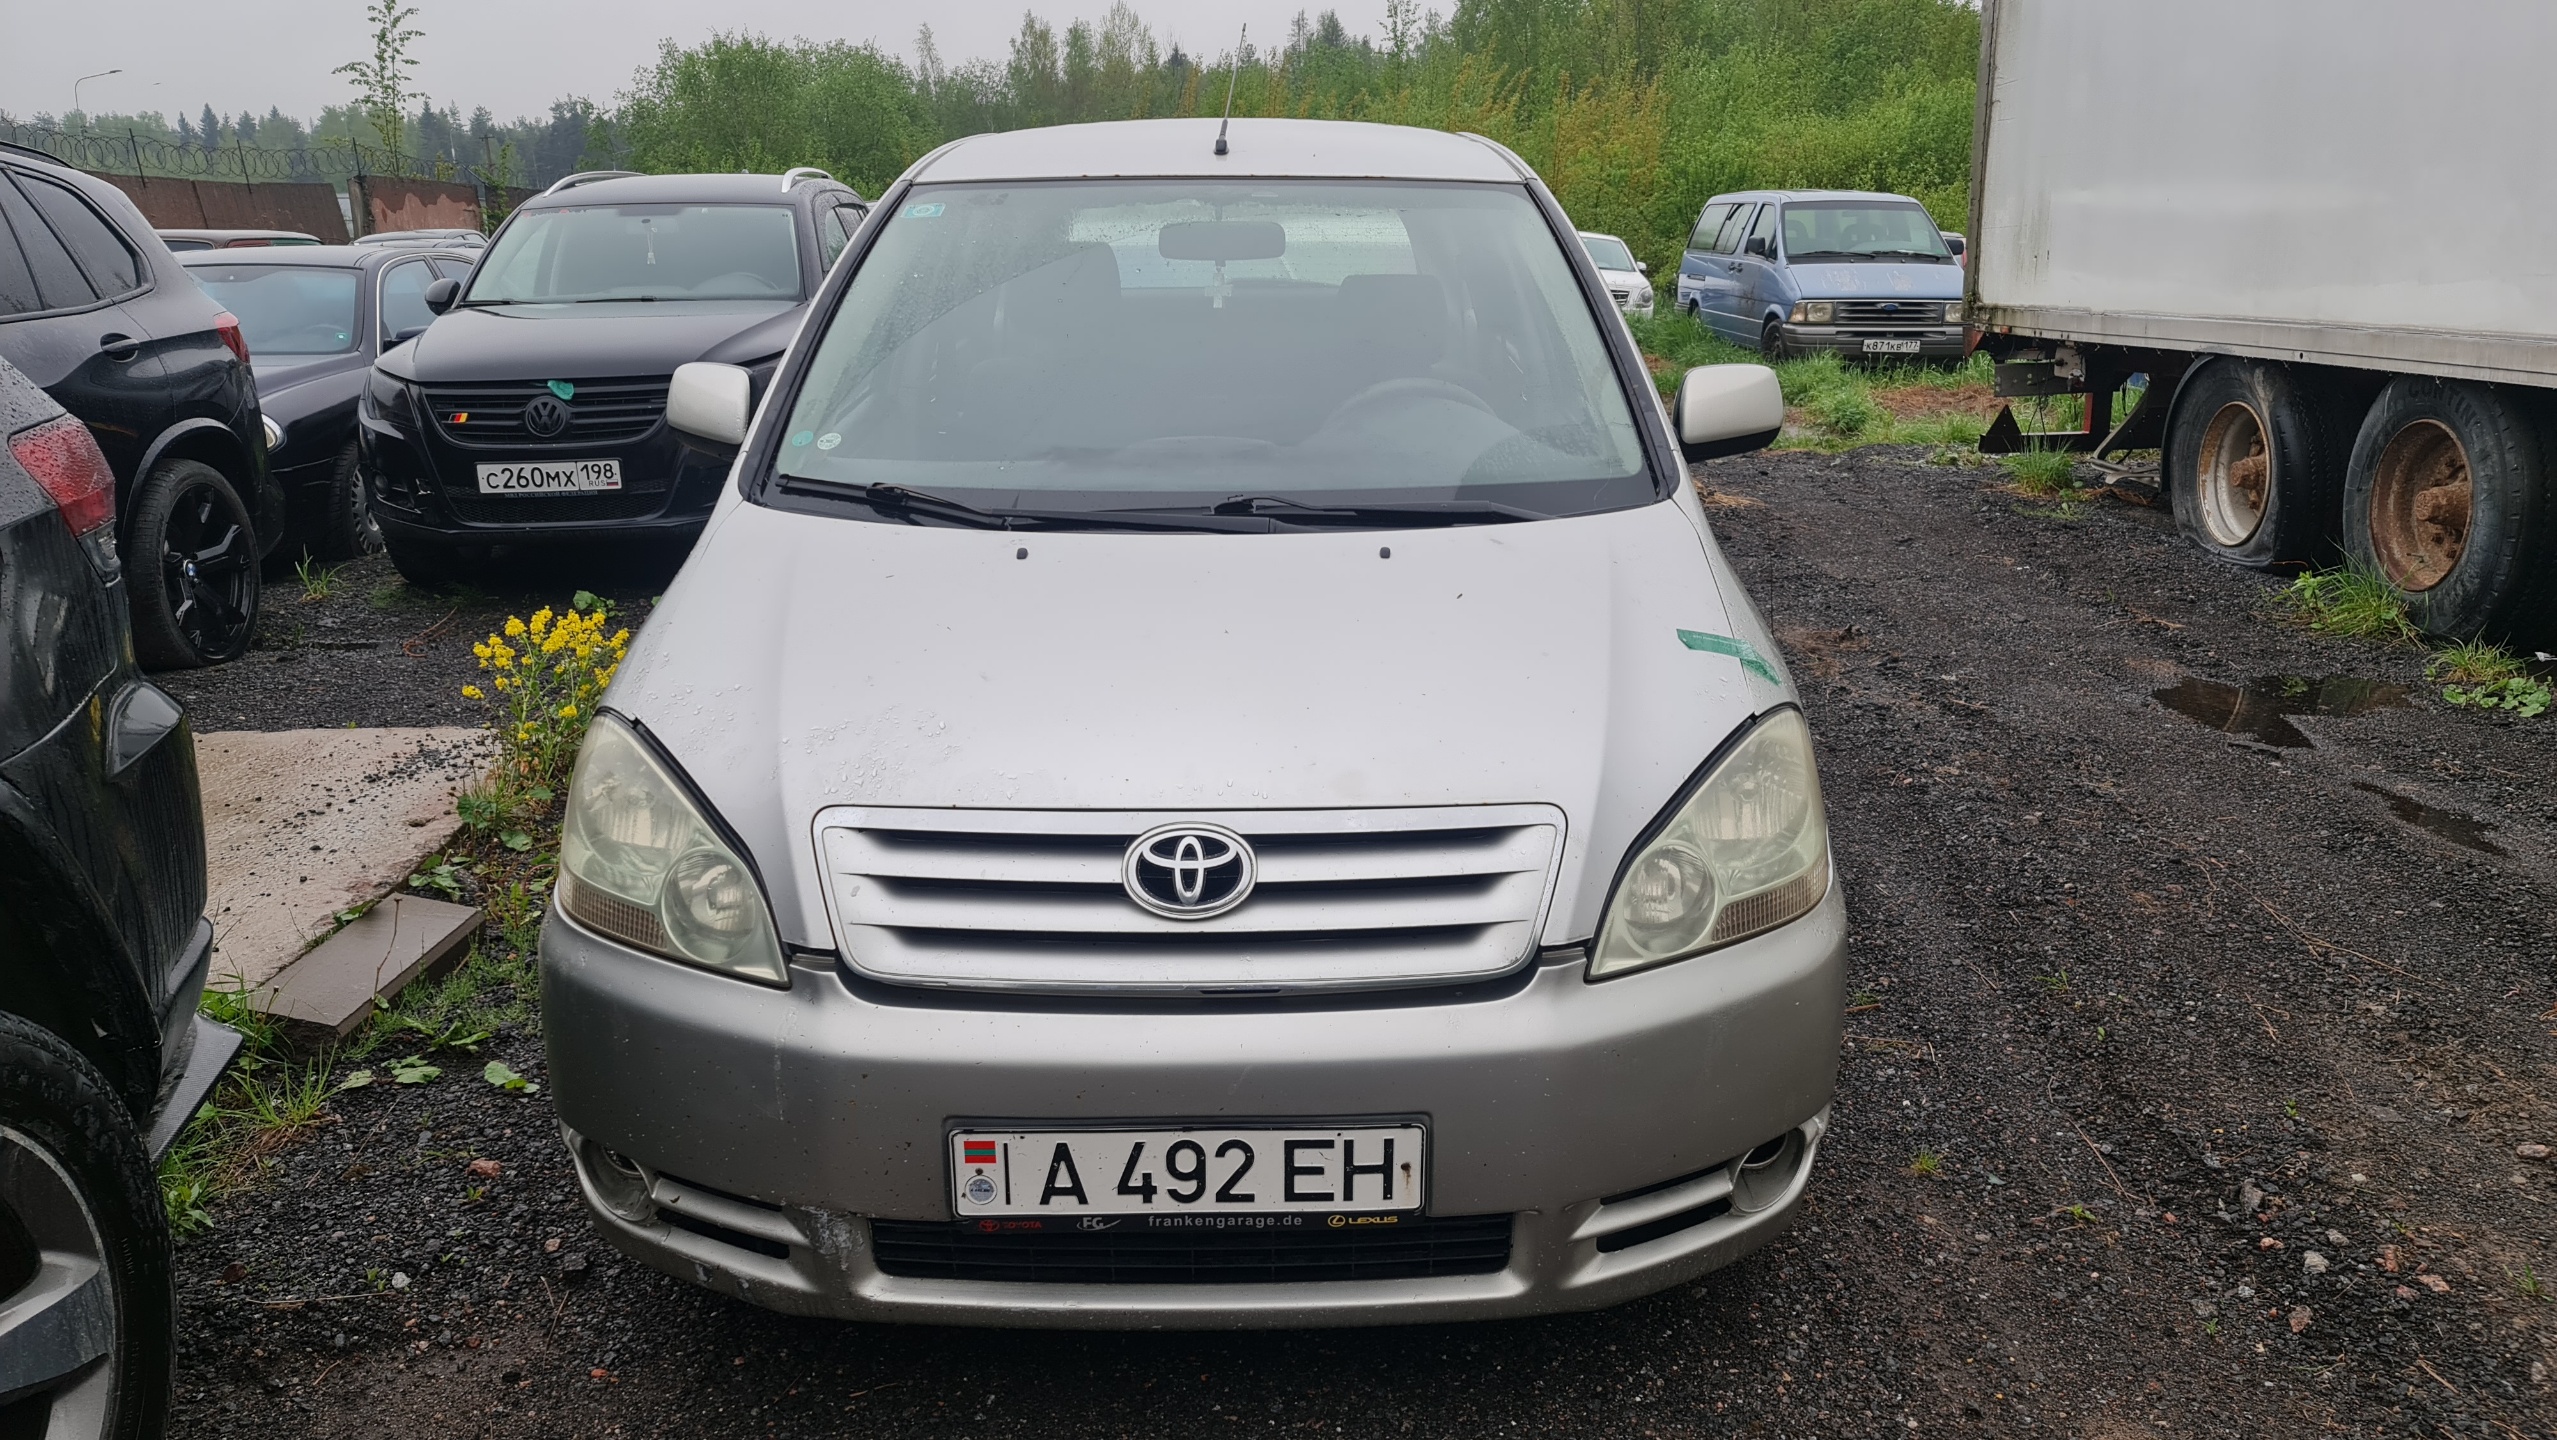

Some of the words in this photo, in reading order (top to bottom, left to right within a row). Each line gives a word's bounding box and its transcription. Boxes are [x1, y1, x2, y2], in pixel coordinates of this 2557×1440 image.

[486, 467, 576, 489] С260МХ
[580, 463, 614, 480] 198
[1039, 1142, 1089, 1205] A
[1117, 1139, 1256, 1204] 492
[1283, 1138, 1395, 1202] EH
[1148, 1215, 1303, 1229] frankengarage.de
[1349, 1216, 1398, 1224] LEXUS
